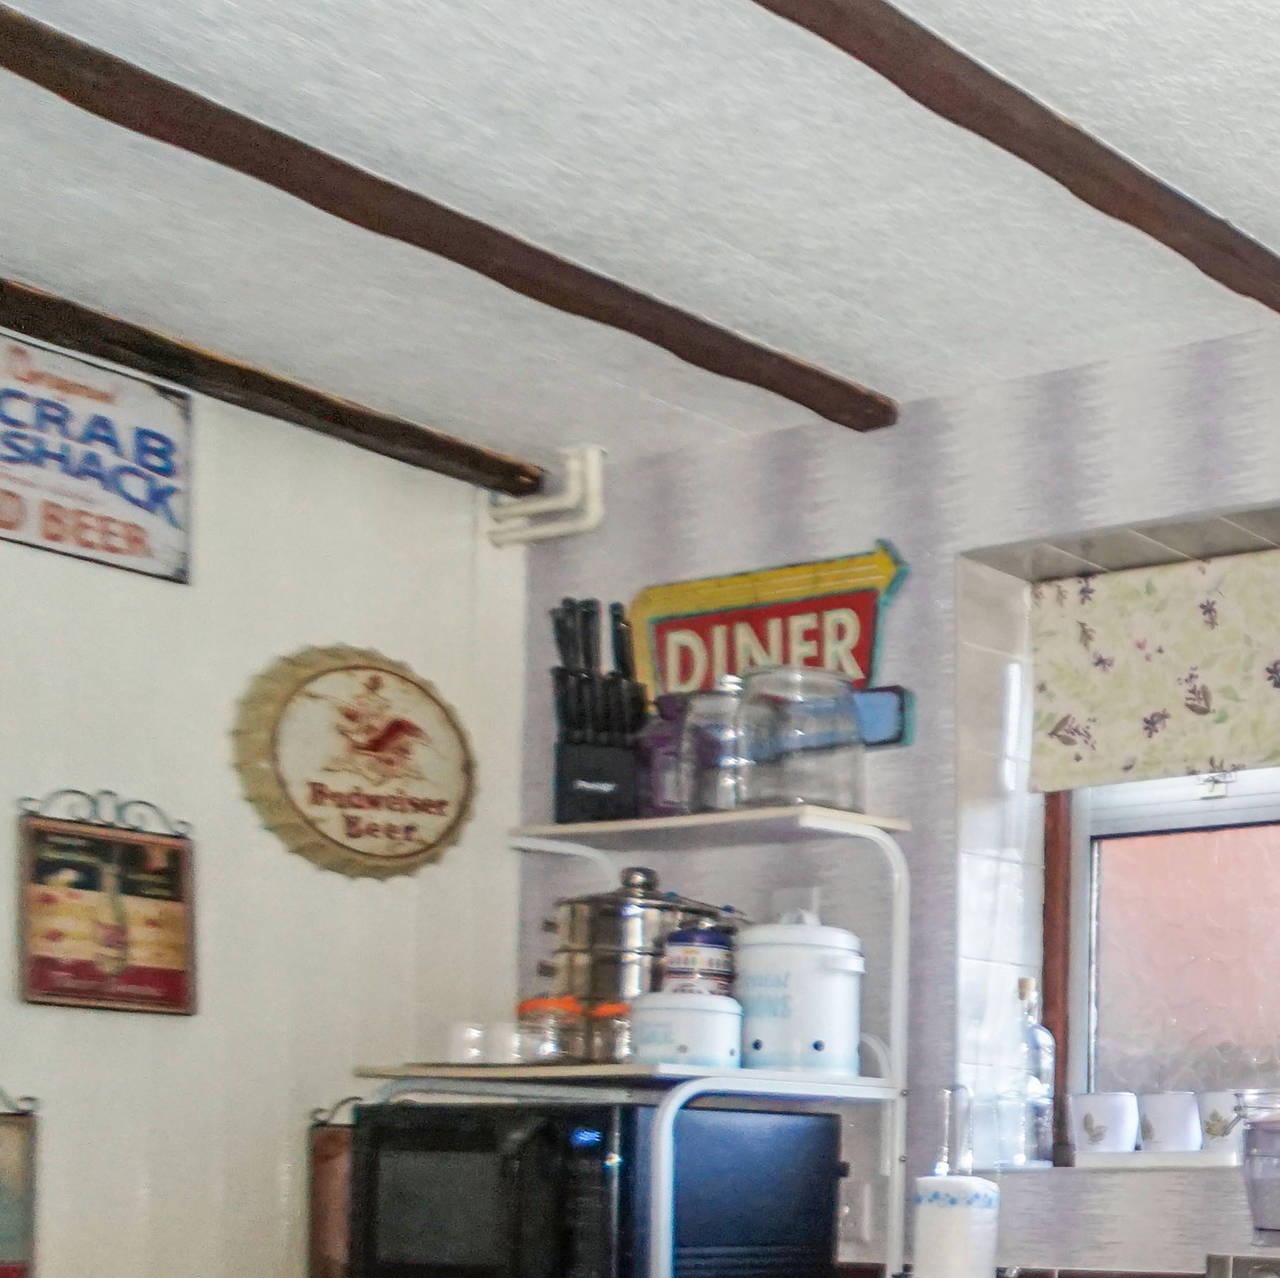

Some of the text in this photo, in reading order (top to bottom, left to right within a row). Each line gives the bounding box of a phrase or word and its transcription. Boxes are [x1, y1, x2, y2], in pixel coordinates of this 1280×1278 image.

[0, 387, 177, 480] CRAB
[0, 429, 184, 533] SHACK
[664, 606, 867, 694] DINER
